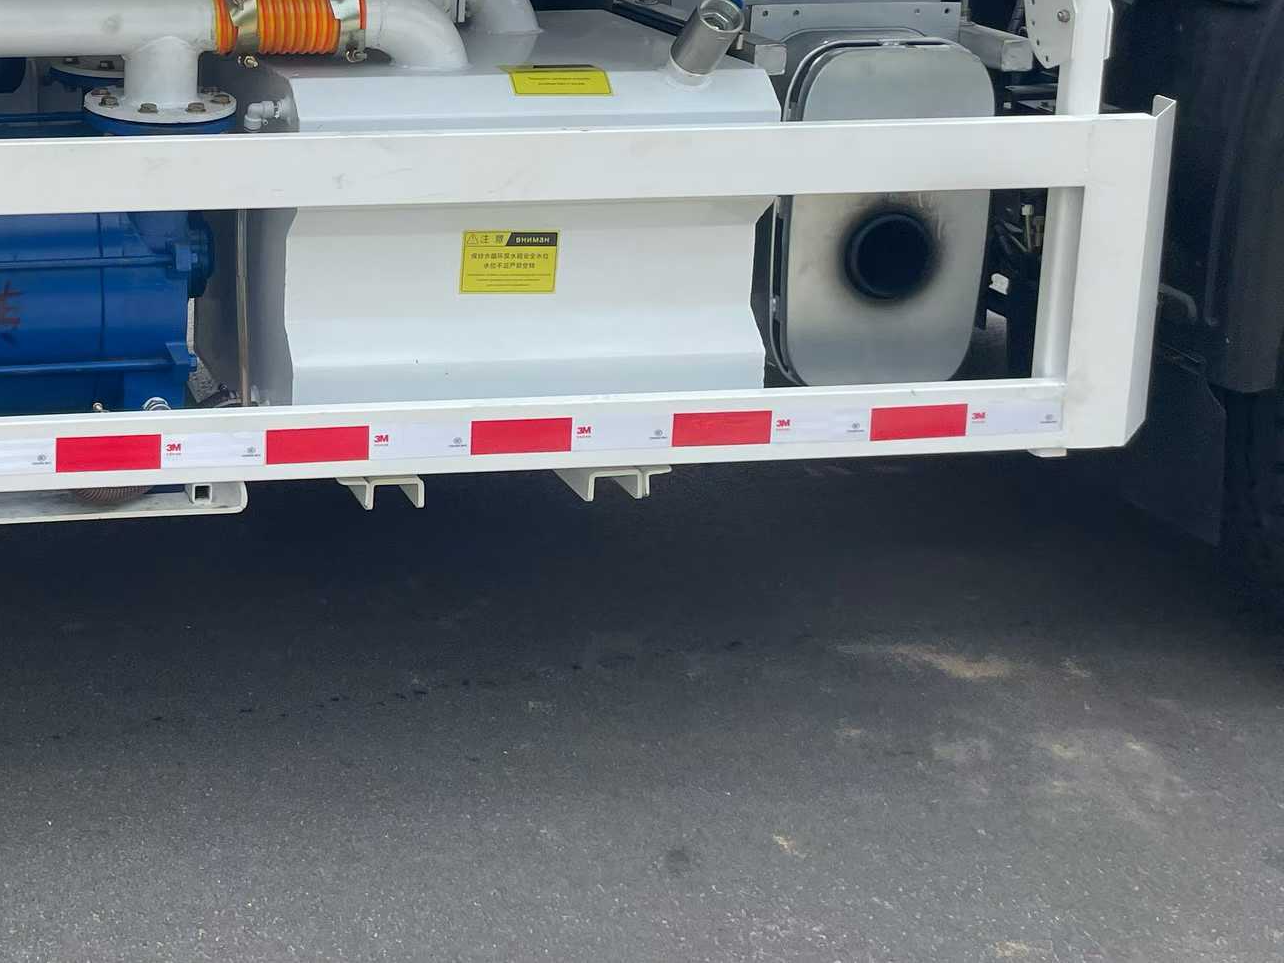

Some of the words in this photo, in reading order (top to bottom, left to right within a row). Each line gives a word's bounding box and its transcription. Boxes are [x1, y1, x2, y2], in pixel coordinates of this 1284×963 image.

[577, 426, 591, 435] 3M
[374, 434, 388, 443] 3M
[166, 444, 181, 452] 3M
